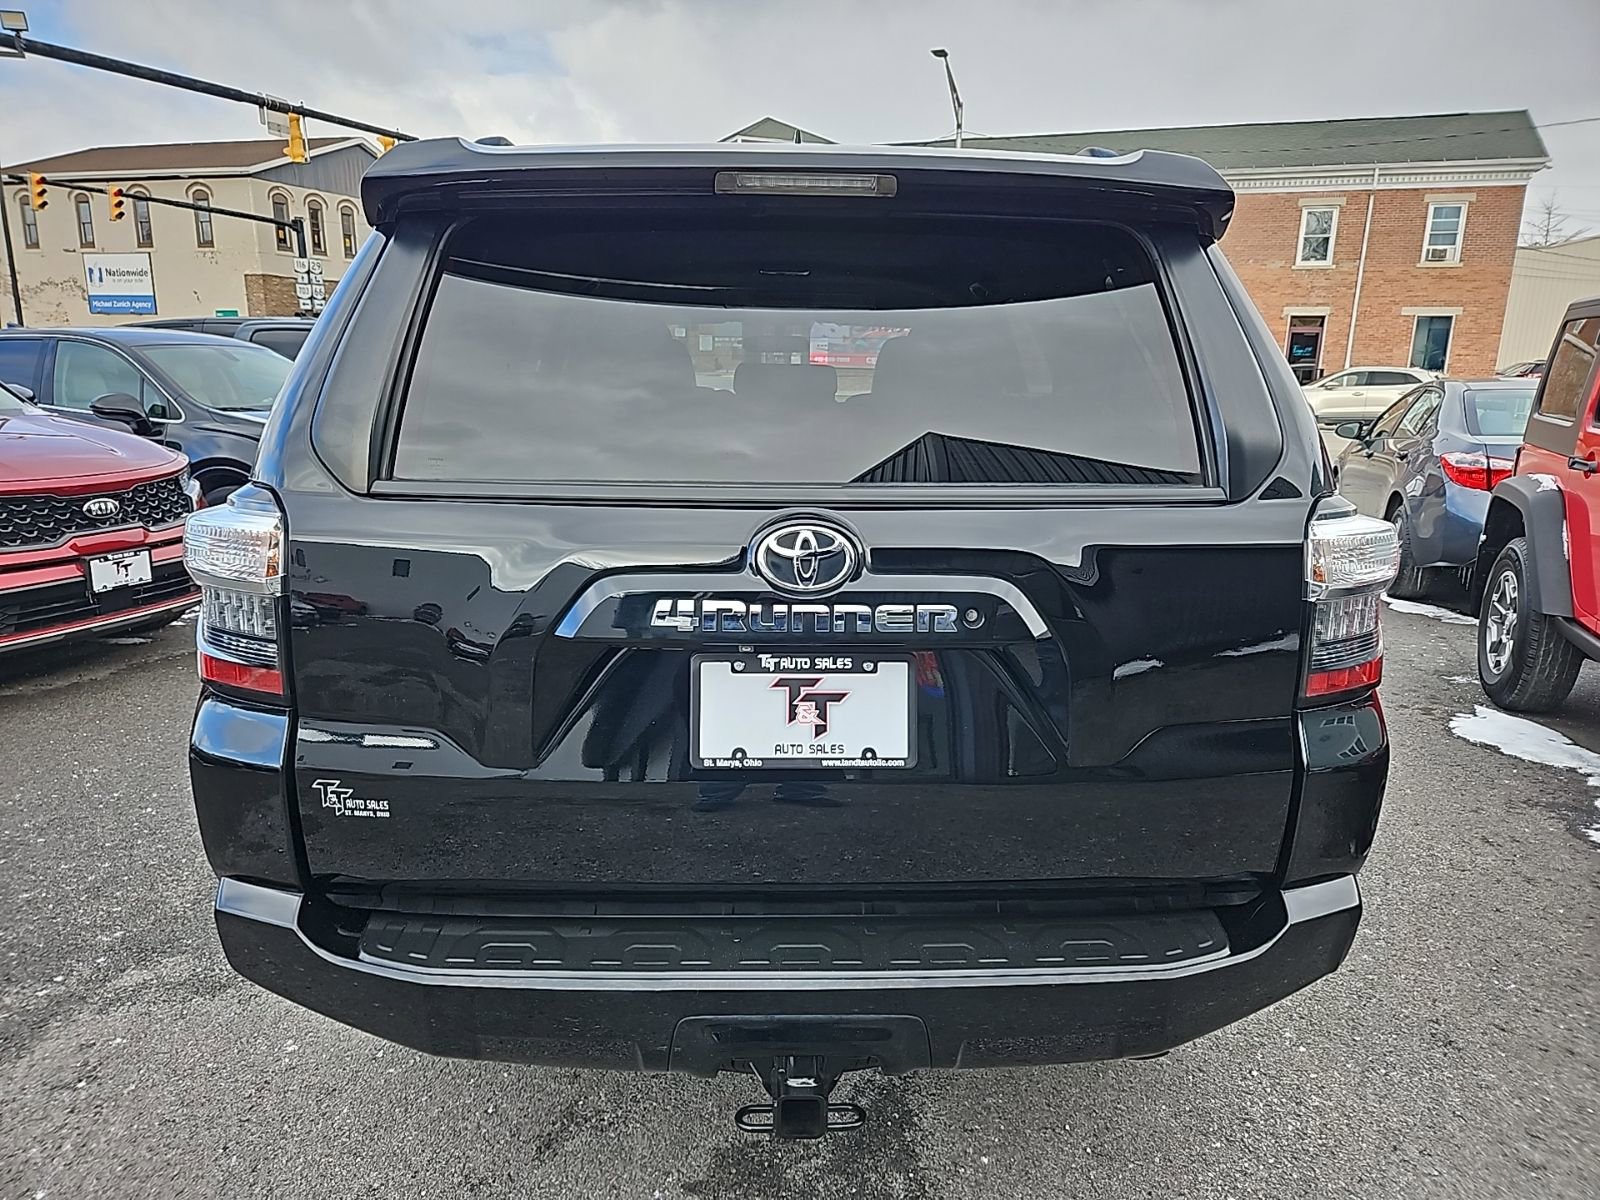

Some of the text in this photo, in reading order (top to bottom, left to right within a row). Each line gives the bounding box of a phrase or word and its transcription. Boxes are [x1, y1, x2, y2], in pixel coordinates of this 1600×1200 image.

[296, 260, 306, 269] 116
[311, 261, 321, 271] 29
[105, 267, 149, 277] Nationwide
[90, 502, 116, 515] KIA
[650, 599, 958, 633] 4RUNNER
[780, 657, 811, 670] AUTO
[814, 657, 853, 670] SALES
[768, 677, 851, 741] T&T
[774, 744, 845, 755] AUTO SALES
[743, 759, 763, 767] Ohio
[311, 779, 354, 816] T&T
[345, 799, 389, 810] AUTO SALES
